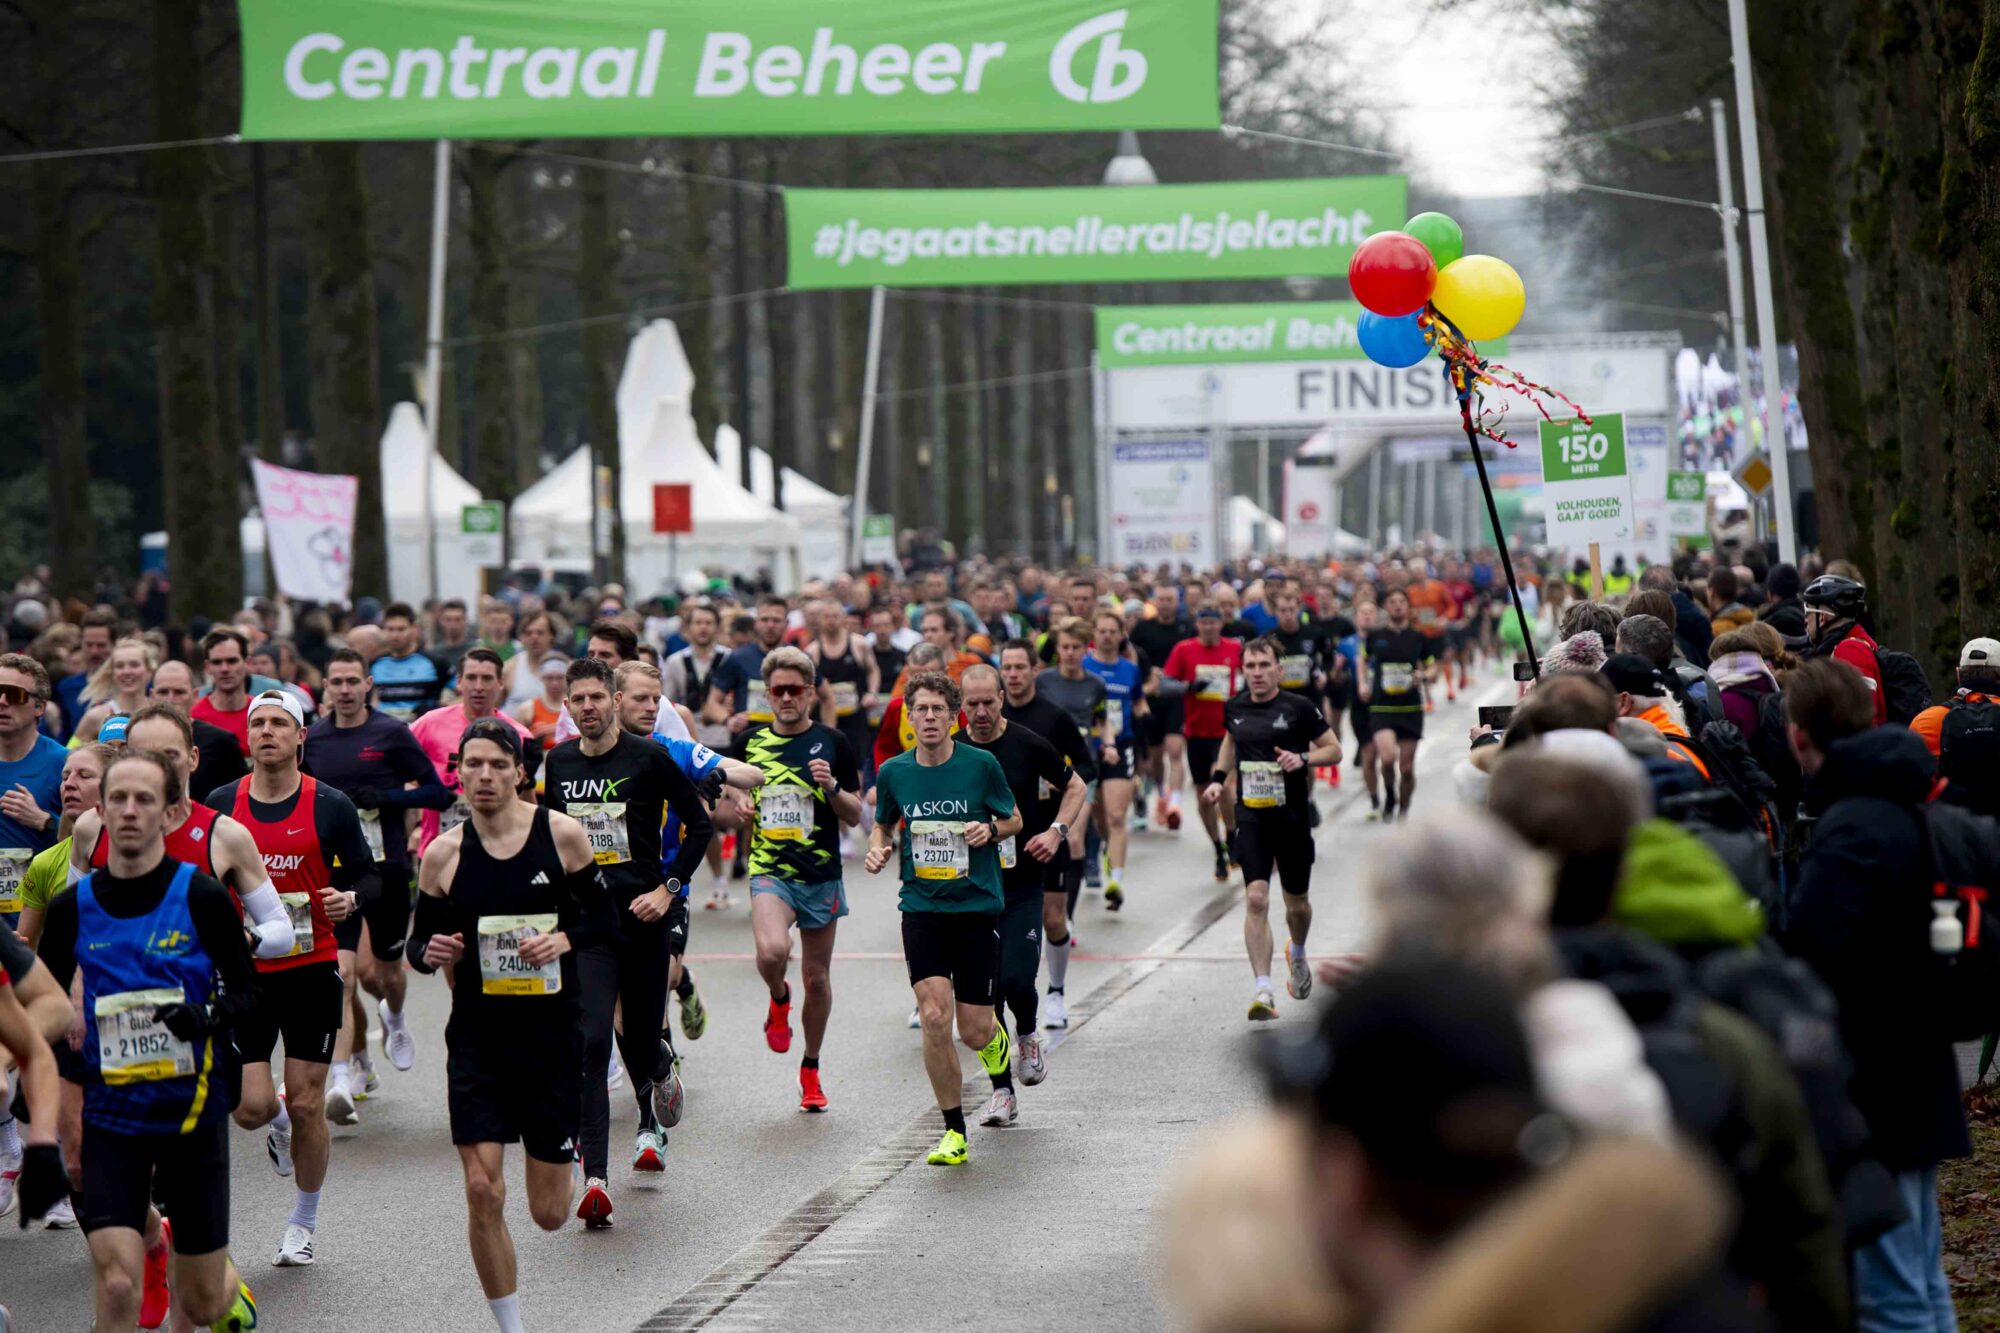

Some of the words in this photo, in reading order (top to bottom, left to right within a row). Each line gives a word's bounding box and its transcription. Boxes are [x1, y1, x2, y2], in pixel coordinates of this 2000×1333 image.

[284, 29, 667, 100] Centraal
[695, 28, 1008, 96] Beheer
[813, 206, 1372, 266] #jegaatsnelleralsjelacht
[1112, 318, 1277, 354] Centraal
[1285, 316, 1359, 349] Beh
[1558, 432, 1609, 463] 150
[1571, 463, 1600, 474] METER
[1556, 497, 1622, 511] VOLHOUDEN,
[1557, 511, 1586, 522] GAAT
[1588, 508, 1620, 520] GOED!
[561, 776, 631, 803] RUNX
[903, 800, 968, 818] KASKON
[772, 812, 801, 823] 24484
[587, 821, 605, 831] RUUD
[588, 834, 614, 847] 3188
[929, 838, 949, 847] MARC
[924, 850, 955, 863] 23707
[119, 1032, 170, 1058] 21852
